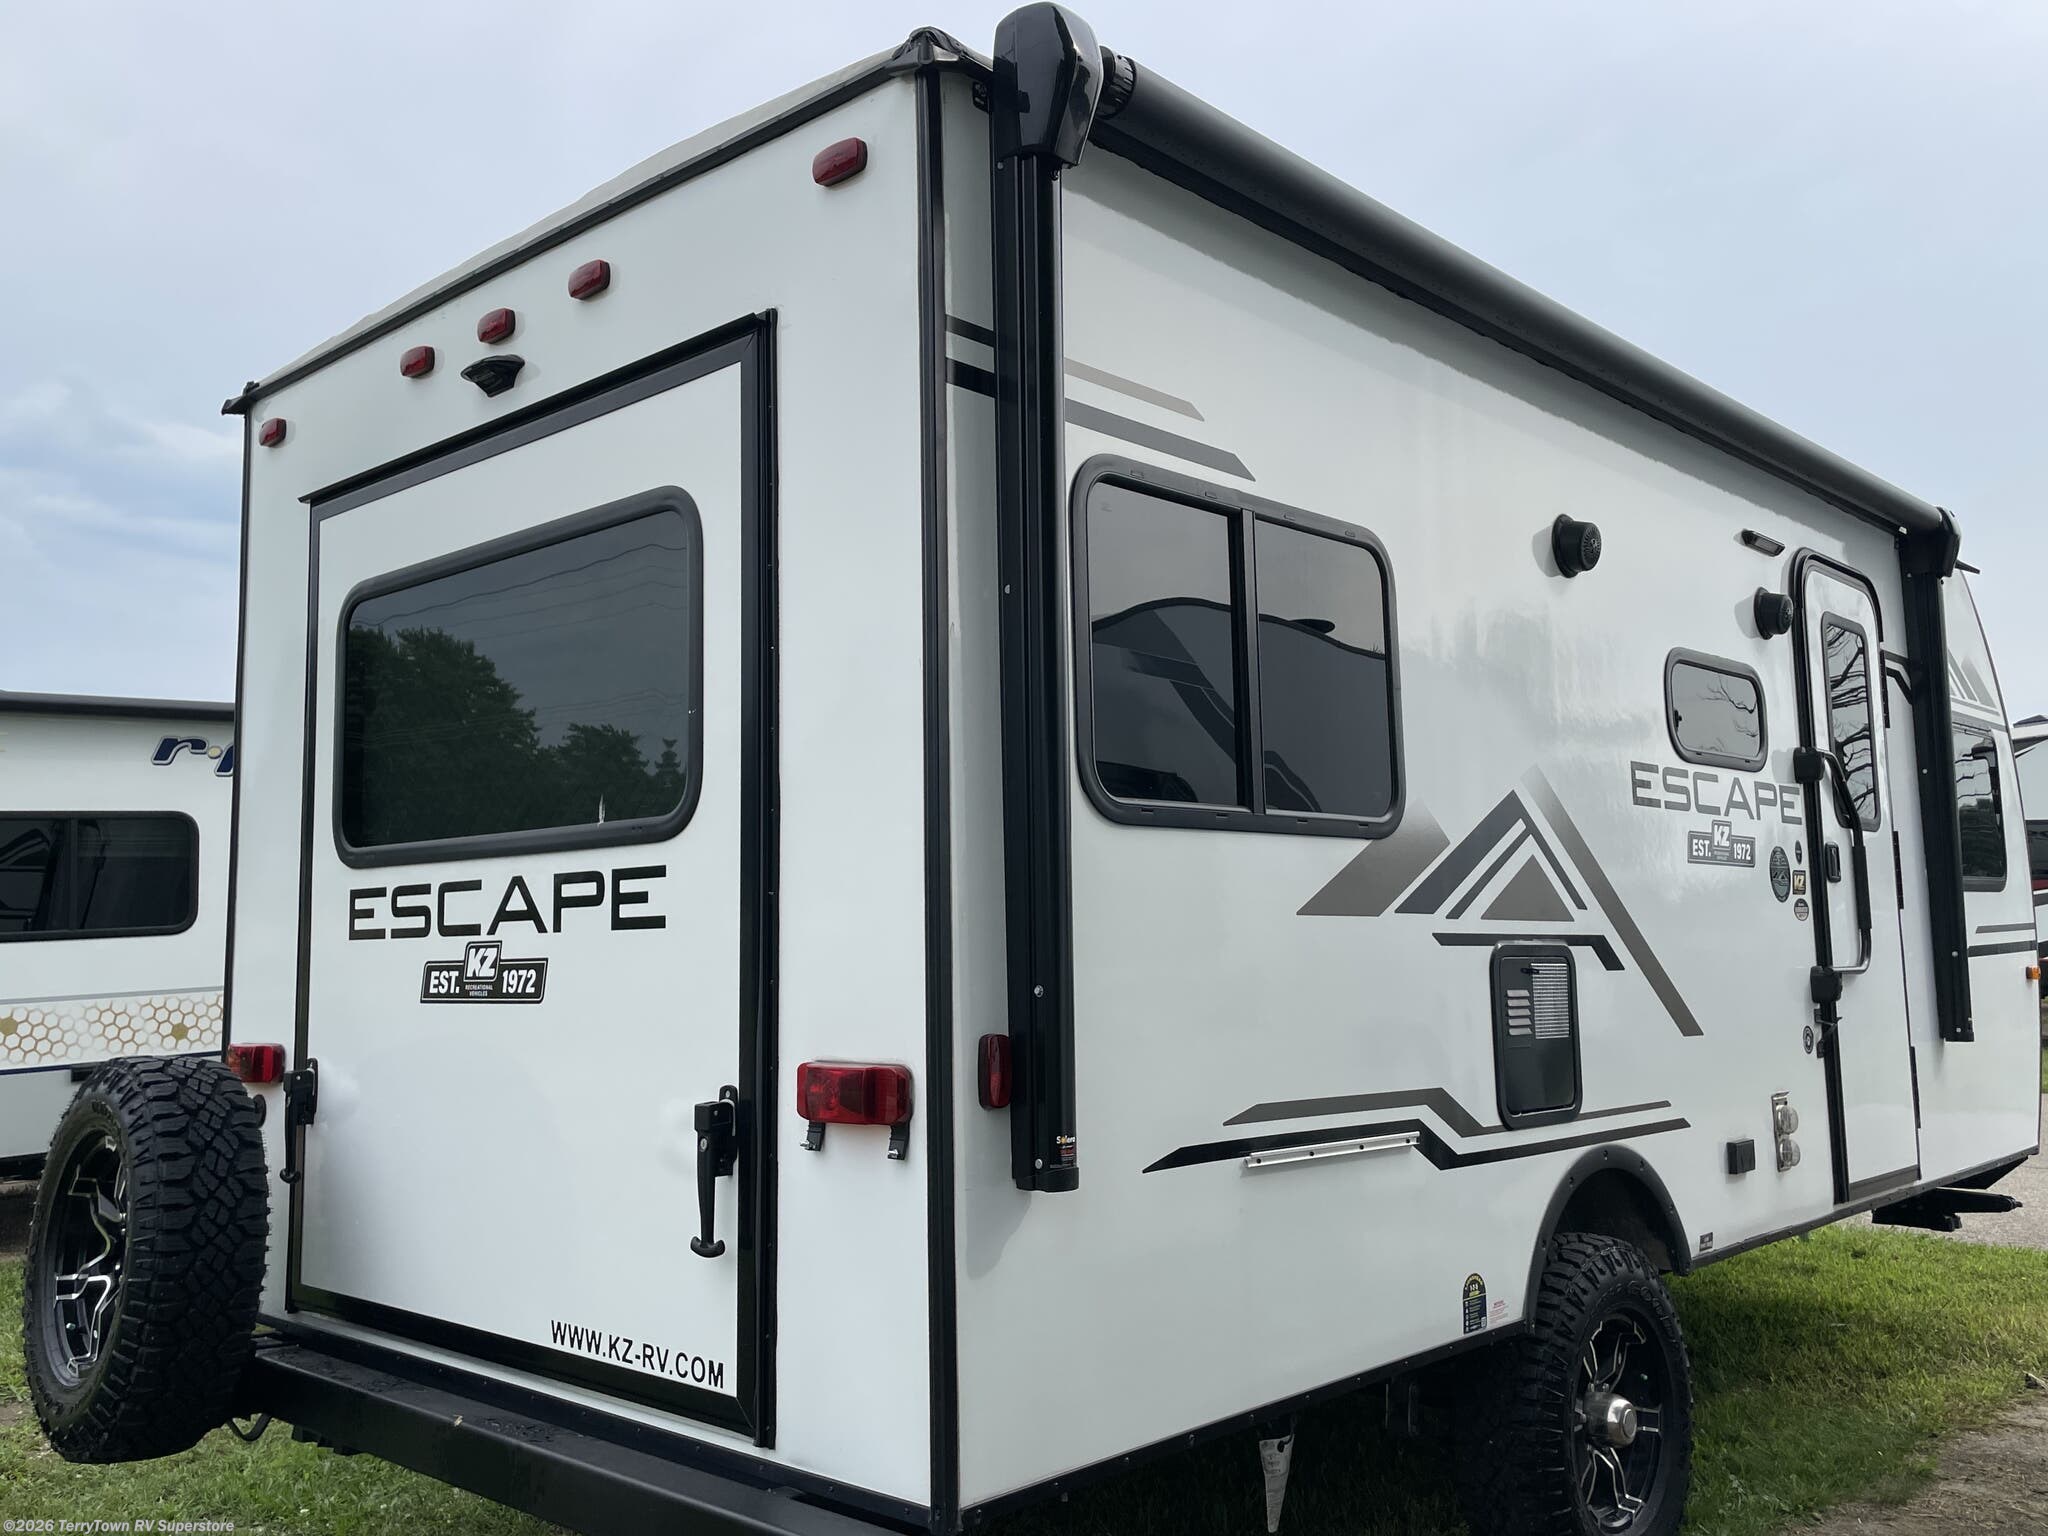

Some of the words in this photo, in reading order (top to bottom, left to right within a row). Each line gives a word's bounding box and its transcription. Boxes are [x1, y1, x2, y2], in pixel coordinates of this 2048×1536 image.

[1630, 760, 1803, 825] ESCAPE
[1692, 838, 1712, 857] EST.
[1733, 843, 1752, 860] 1972
[1713, 825, 1730, 847] KZ
[348, 864, 667, 941] ESCAPE
[466, 947, 498, 978] KZ
[428, 970, 460, 994] EST.
[501, 969, 537, 994] 1972
[550, 1319, 724, 1389] WWW.KZ-RV.COM
